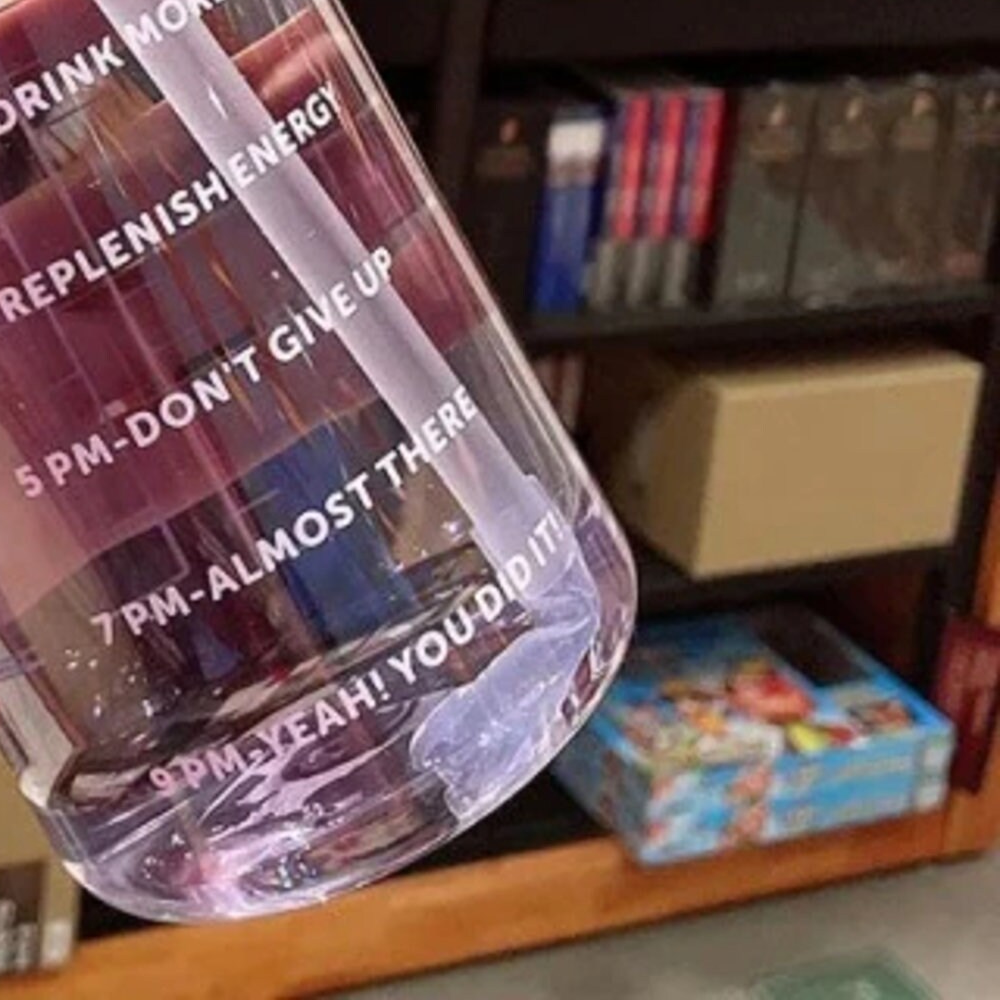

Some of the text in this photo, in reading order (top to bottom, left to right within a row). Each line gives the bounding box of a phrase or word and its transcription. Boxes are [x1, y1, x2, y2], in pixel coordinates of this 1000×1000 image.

[225, 80, 343, 190] ENERGY
[14, 245, 394, 498] 5 PM-DON'T GIVE UP
[89, 384, 479, 646] 7 PM-ALMOST THERE
[178, 668, 392, 789] PM-YEAH!
[386, 604, 475, 686] YOU
[474, 552, 532, 622] DID
[526, 509, 564, 567] IT!
